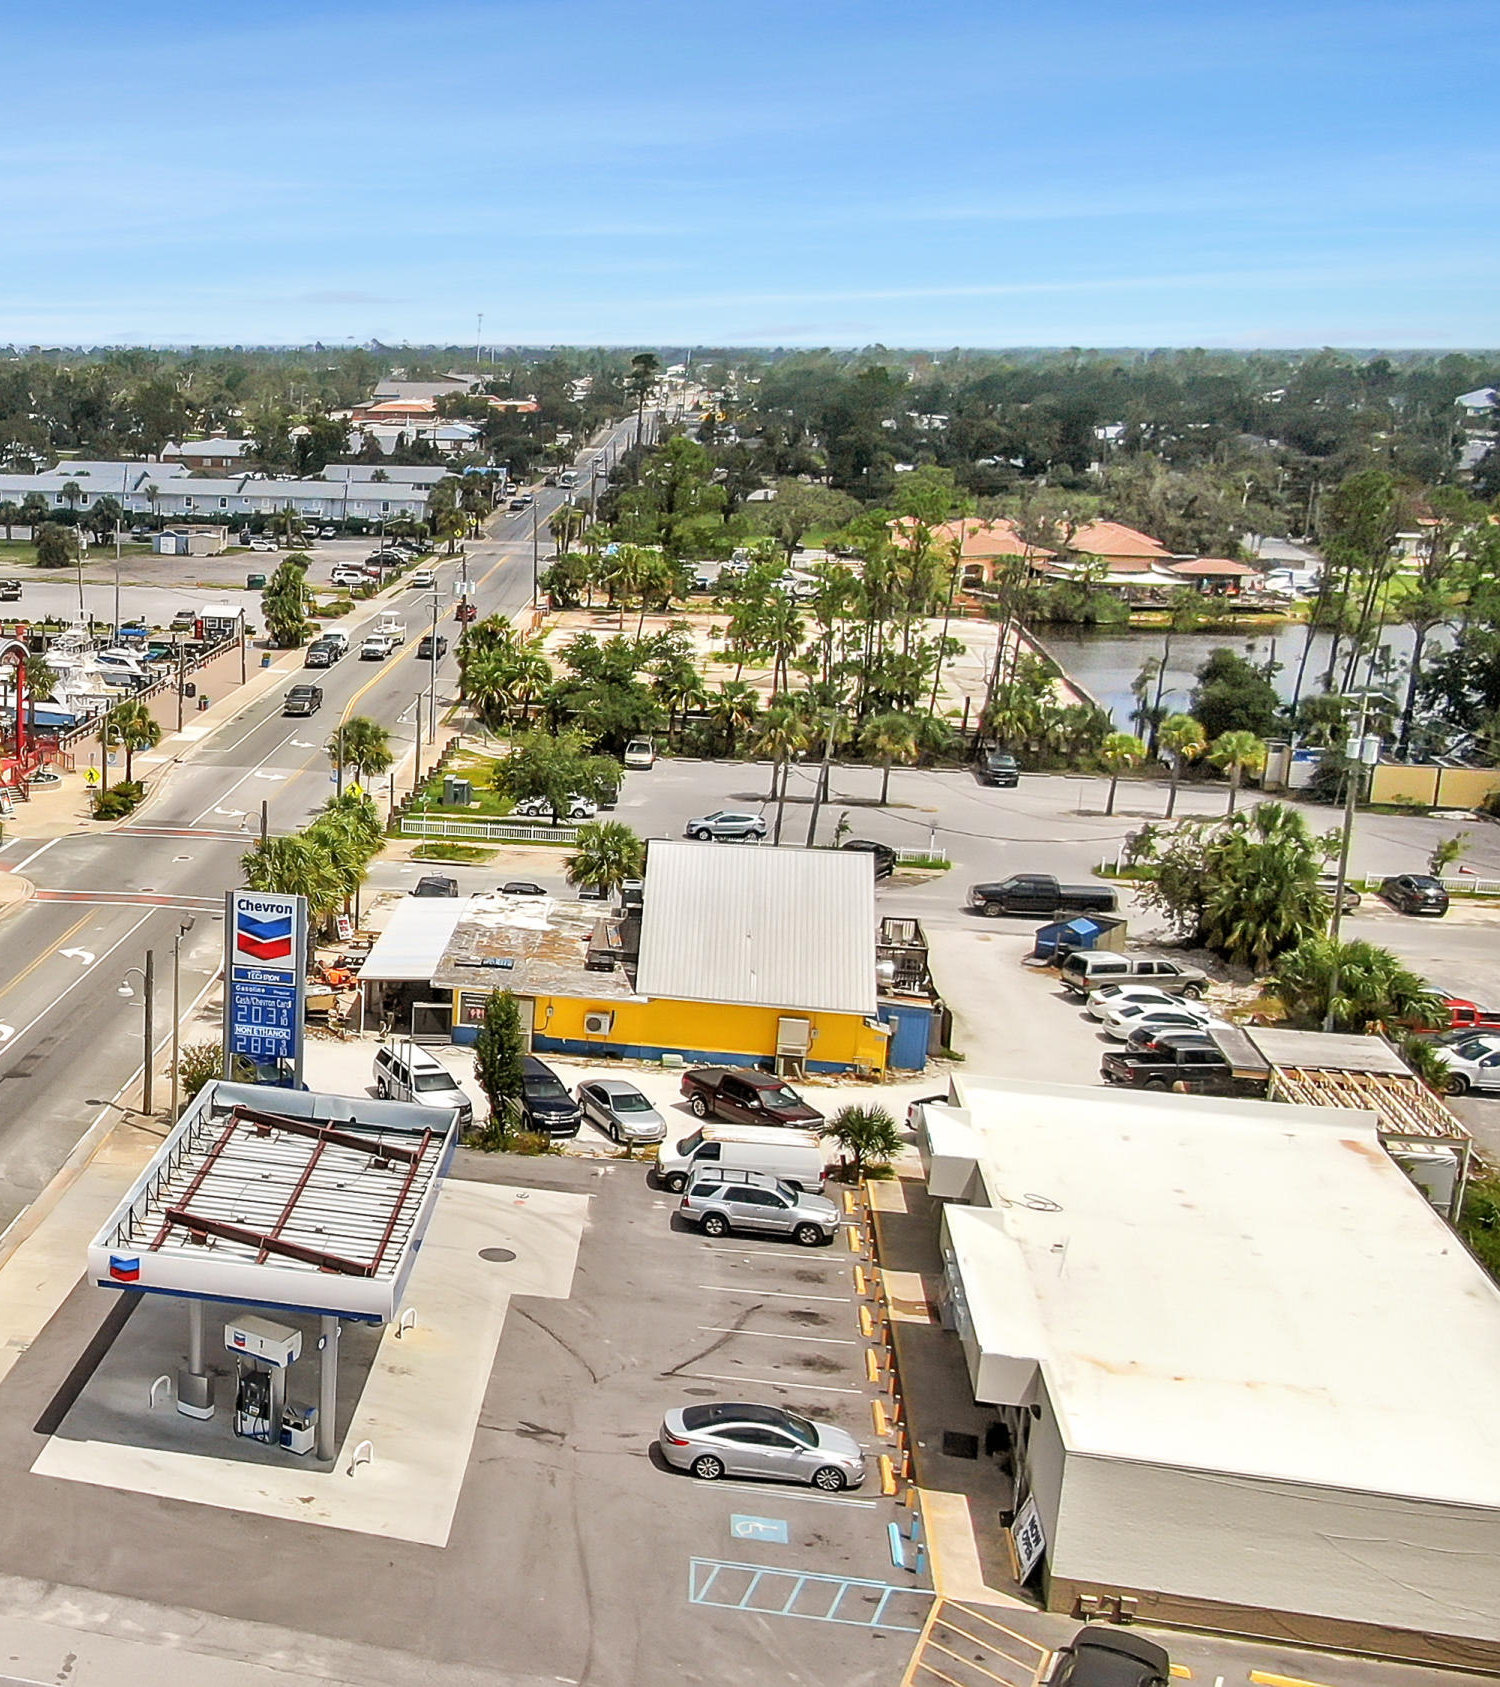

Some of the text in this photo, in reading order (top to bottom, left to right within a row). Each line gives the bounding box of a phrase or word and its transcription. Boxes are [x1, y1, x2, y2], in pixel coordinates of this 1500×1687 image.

[237, 898, 293, 914] Chevron
[235, 985, 266, 993] Gasoline
[277, 1000, 292, 1008] Card
[259, 1339, 263, 1349] 1
